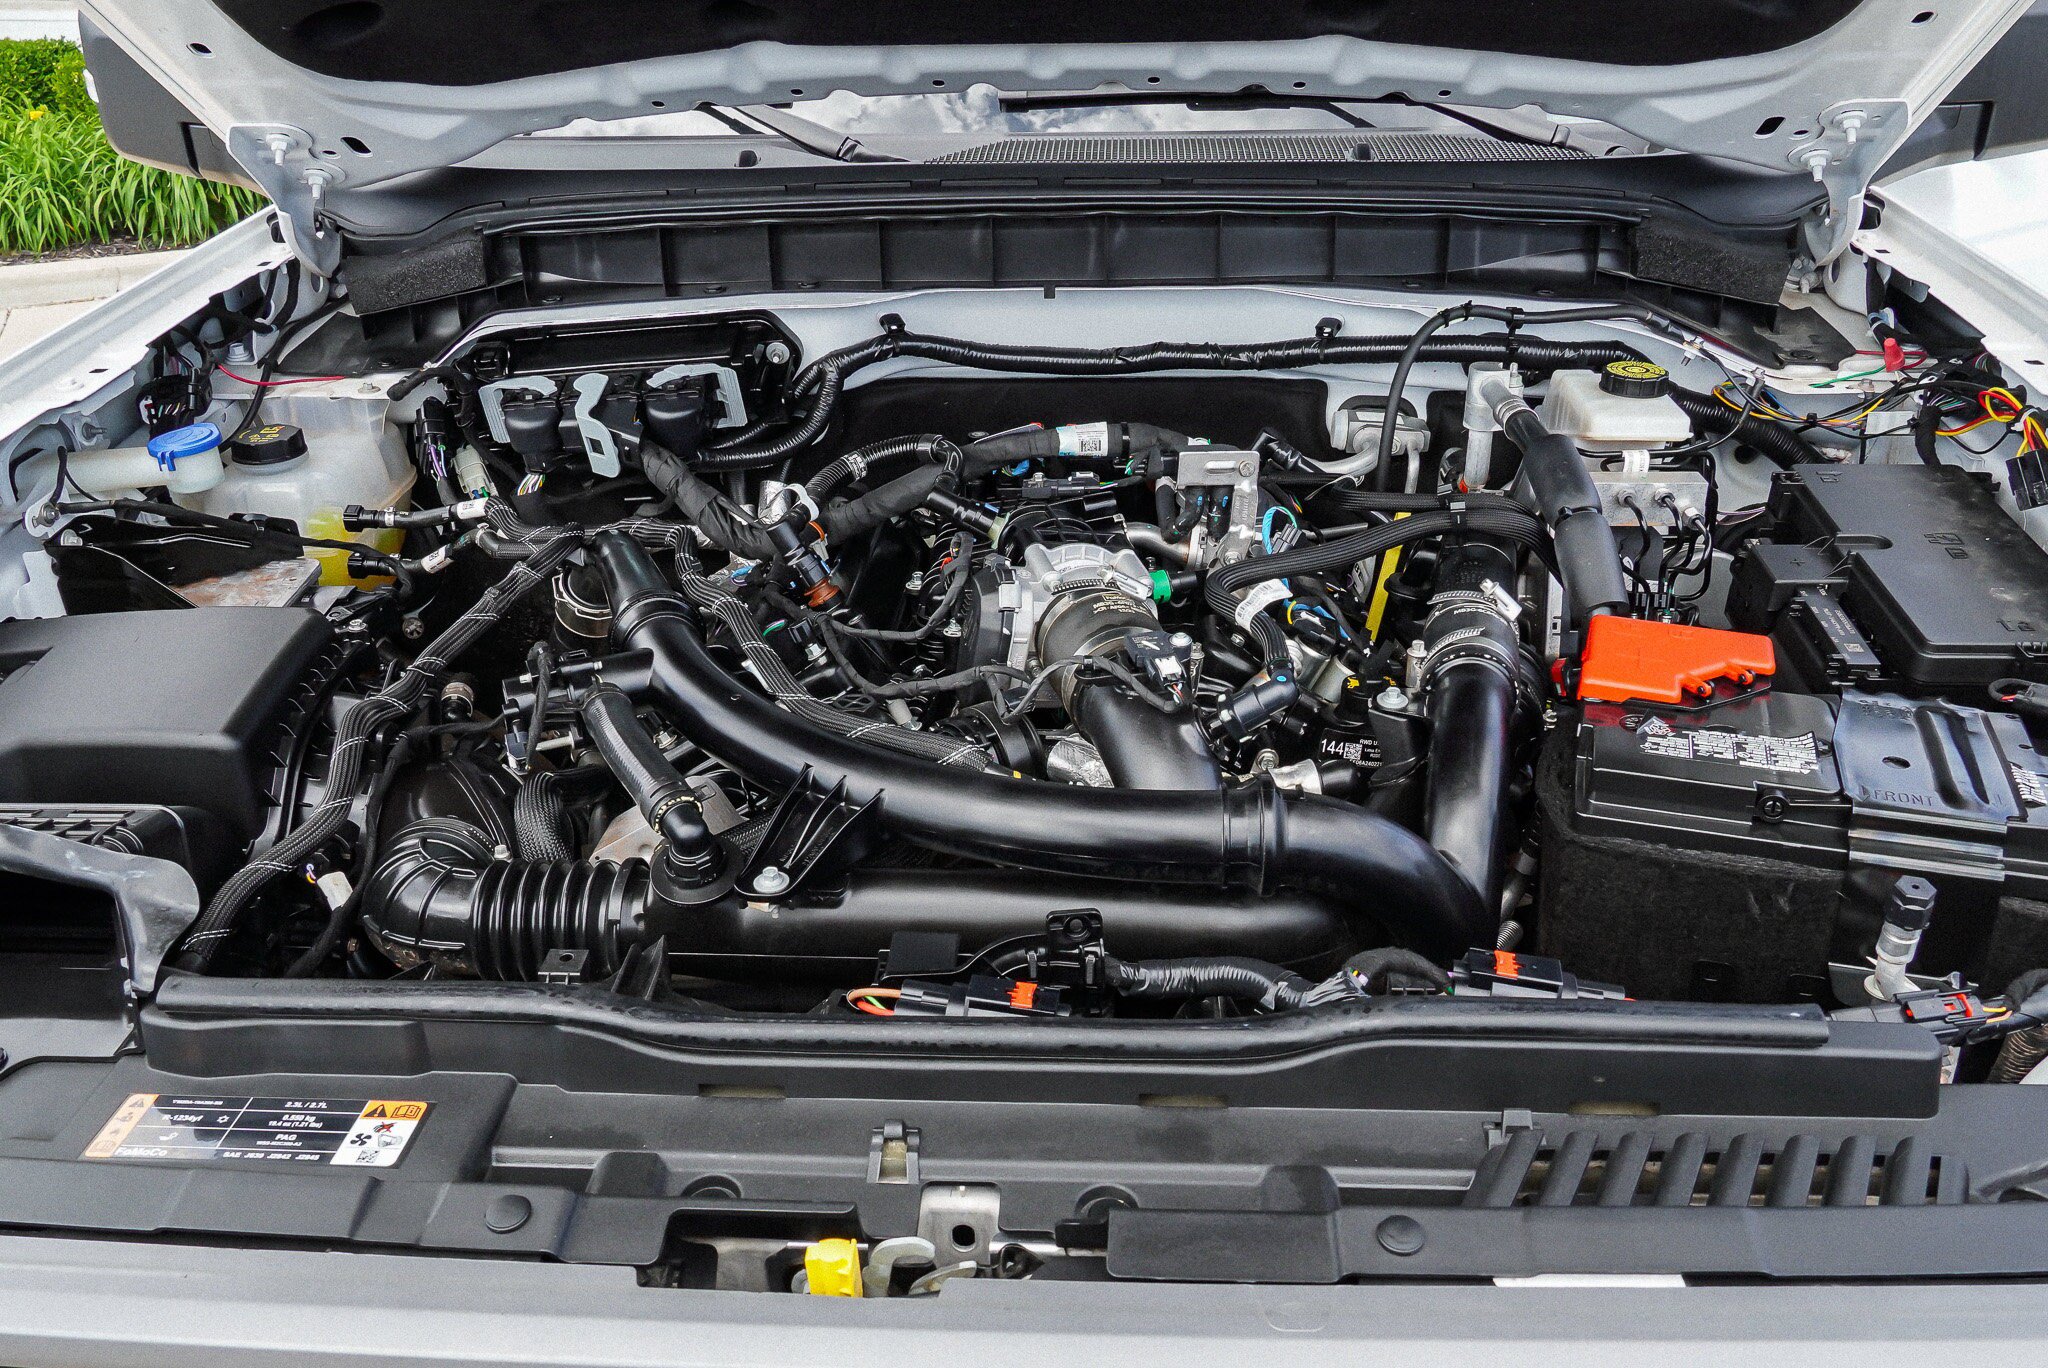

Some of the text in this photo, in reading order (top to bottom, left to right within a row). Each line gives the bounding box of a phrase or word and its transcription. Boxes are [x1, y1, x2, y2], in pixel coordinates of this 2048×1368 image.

[1321, 738, 1344, 755] 144
[1359, 738, 1373, 746] RWD
[1873, 789, 1933, 806] FRONT
[162, 1114, 204, 1124] R-1234yf
[304, 1115, 316, 1123] kg
[275, 1133, 297, 1141] PAG
[113, 1147, 168, 1157] FoMoCo
